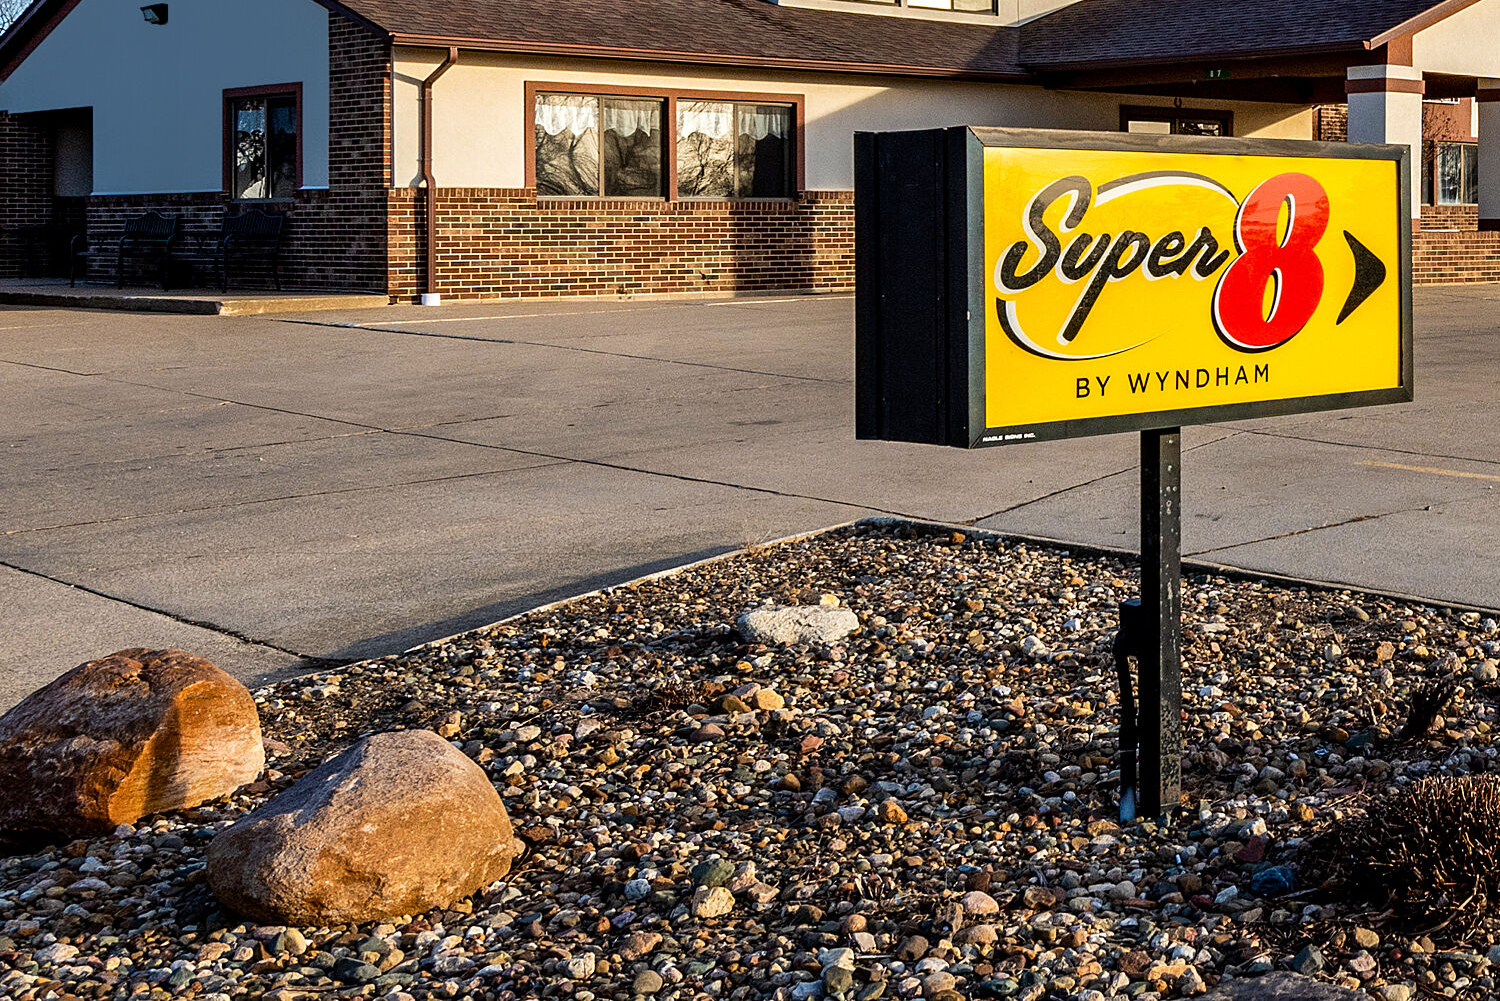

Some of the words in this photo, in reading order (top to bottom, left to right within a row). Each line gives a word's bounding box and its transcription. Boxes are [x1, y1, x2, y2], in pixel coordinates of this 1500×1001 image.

[994, 175, 1230, 346] Super
[1211, 172, 1330, 354] 8
[1076, 375, 1111, 399] BY
[1127, 363, 1270, 394] WYNDHAM
